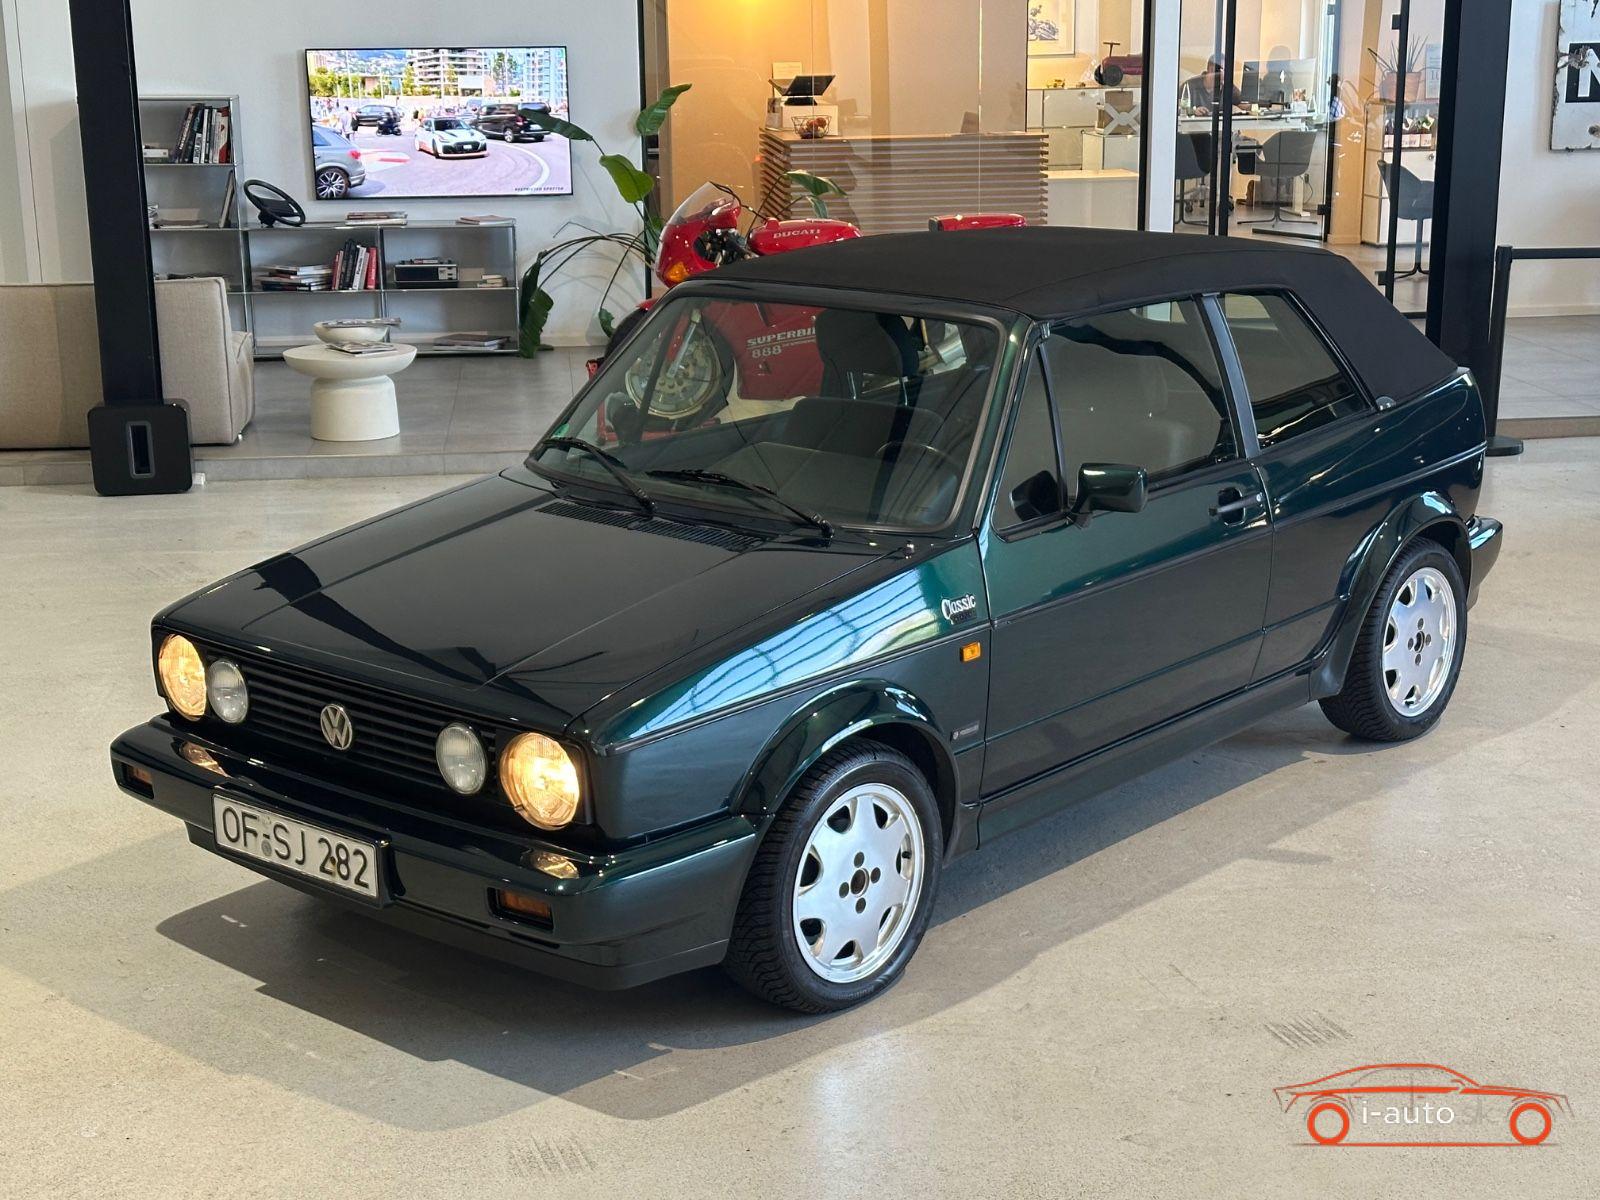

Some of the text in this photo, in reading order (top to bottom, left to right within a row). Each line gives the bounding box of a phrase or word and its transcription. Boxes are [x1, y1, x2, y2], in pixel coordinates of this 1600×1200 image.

[773, 228, 821, 239] DUCATI
[752, 345, 782, 359] 888
[941, 594, 976, 625] Classic
[318, 837, 369, 889] 282
